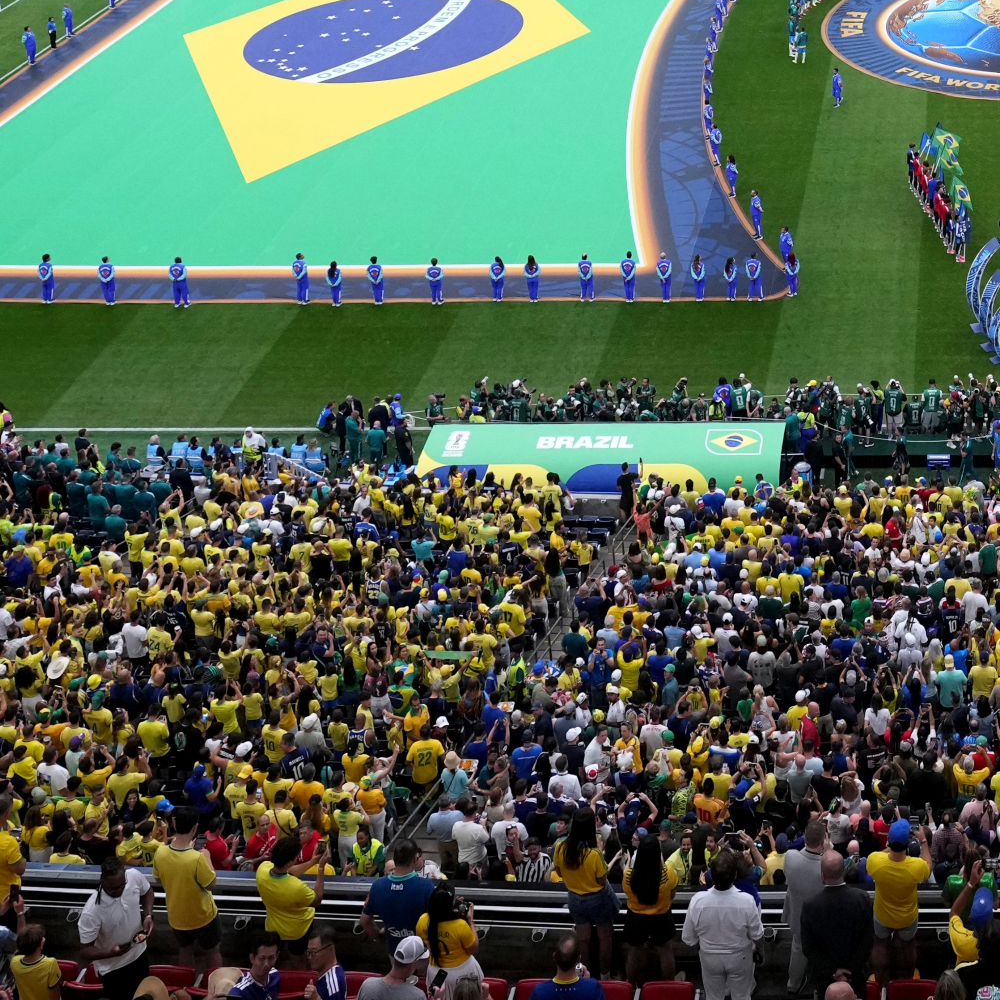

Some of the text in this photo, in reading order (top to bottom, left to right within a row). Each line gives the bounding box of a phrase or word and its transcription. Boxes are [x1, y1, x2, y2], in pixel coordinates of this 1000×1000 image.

[841, 11, 868, 38] FIFA
[317, 30, 428, 79] PROGRESSO
[895, 67, 941, 84] FIFA
[536, 436, 634, 449] BRAZIL
[506, 552, 512, 562] 4
[843, 575, 849, 586] 11
[503, 612, 513, 622] 17
[948, 620, 957, 633] 10
[150, 642, 160, 651] 24
[94, 723, 98, 734] 4
[266, 740, 275, 751] 10
[418, 753, 431, 767] 22
[292, 762, 304, 780] 10
[699, 808, 710, 822] 10
